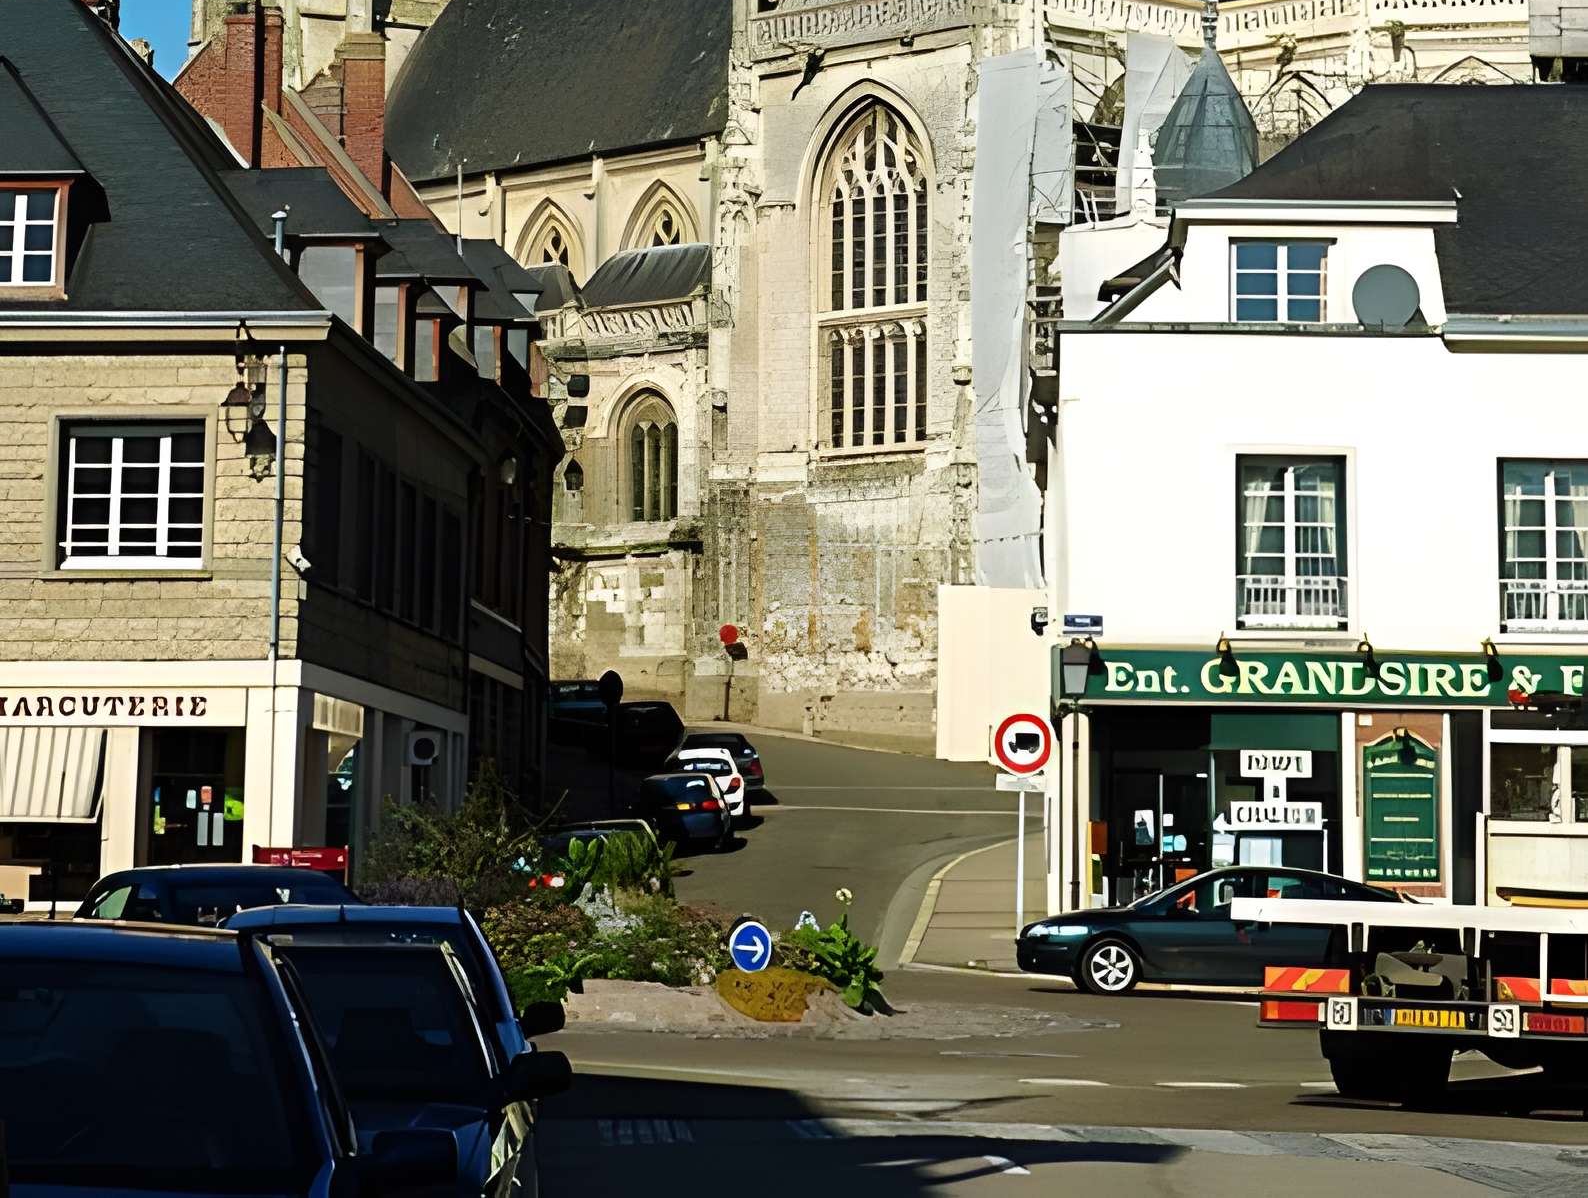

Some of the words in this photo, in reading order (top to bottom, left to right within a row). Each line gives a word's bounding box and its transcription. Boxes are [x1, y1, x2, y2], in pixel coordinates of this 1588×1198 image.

[1104, 661, 1190, 693] Ent.
[1201, 658, 1491, 694] GRANDSIRE
[1508, 666, 1543, 694] &
